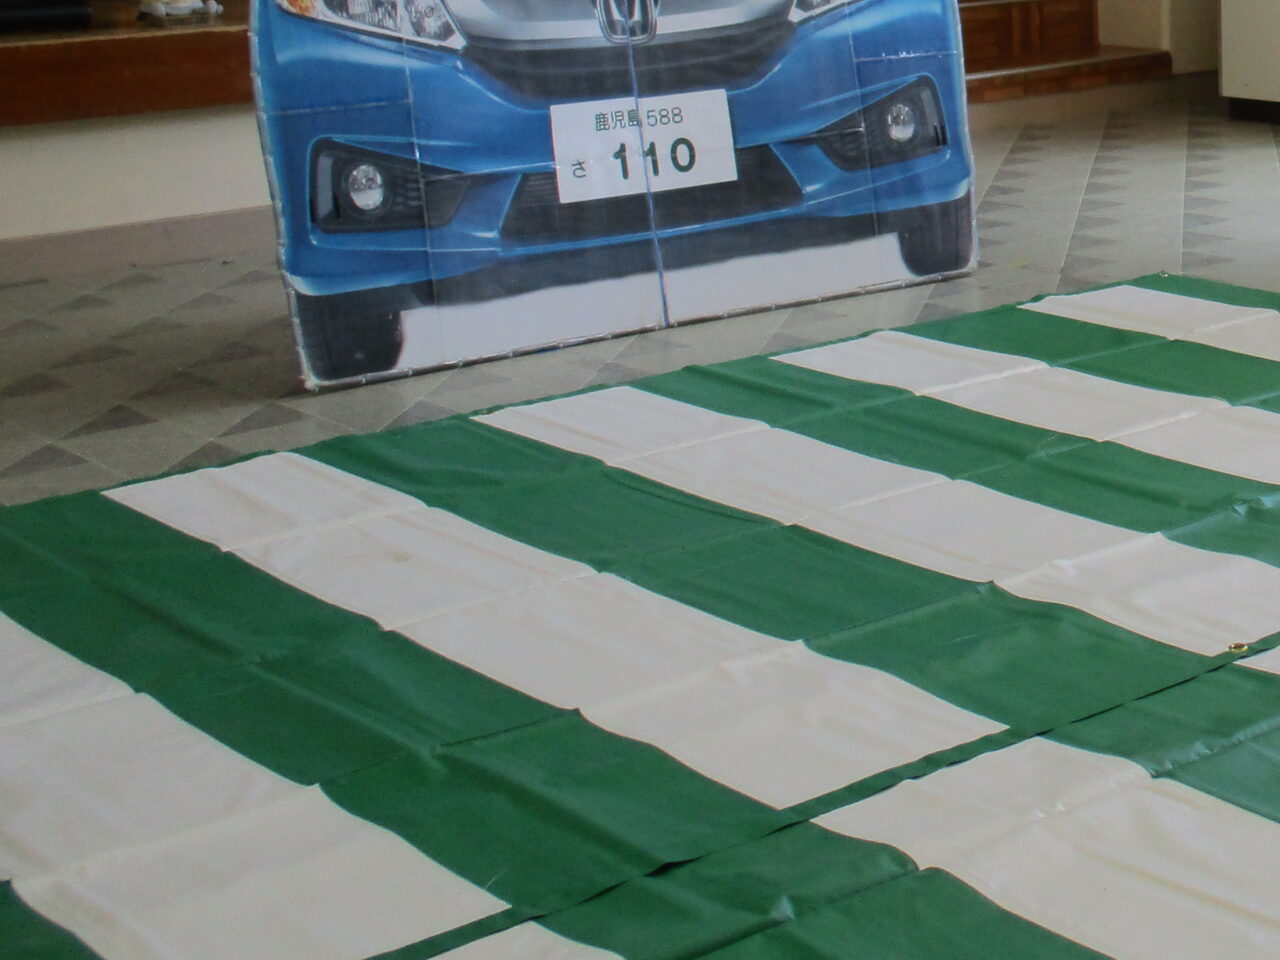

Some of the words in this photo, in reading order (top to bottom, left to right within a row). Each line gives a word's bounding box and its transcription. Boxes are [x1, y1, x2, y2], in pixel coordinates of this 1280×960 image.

[594, 109, 642, 132] 鹿児島
[646, 107, 684, 127] 588
[571, 159, 587, 179] さ
[612, 137, 696, 180] 110
